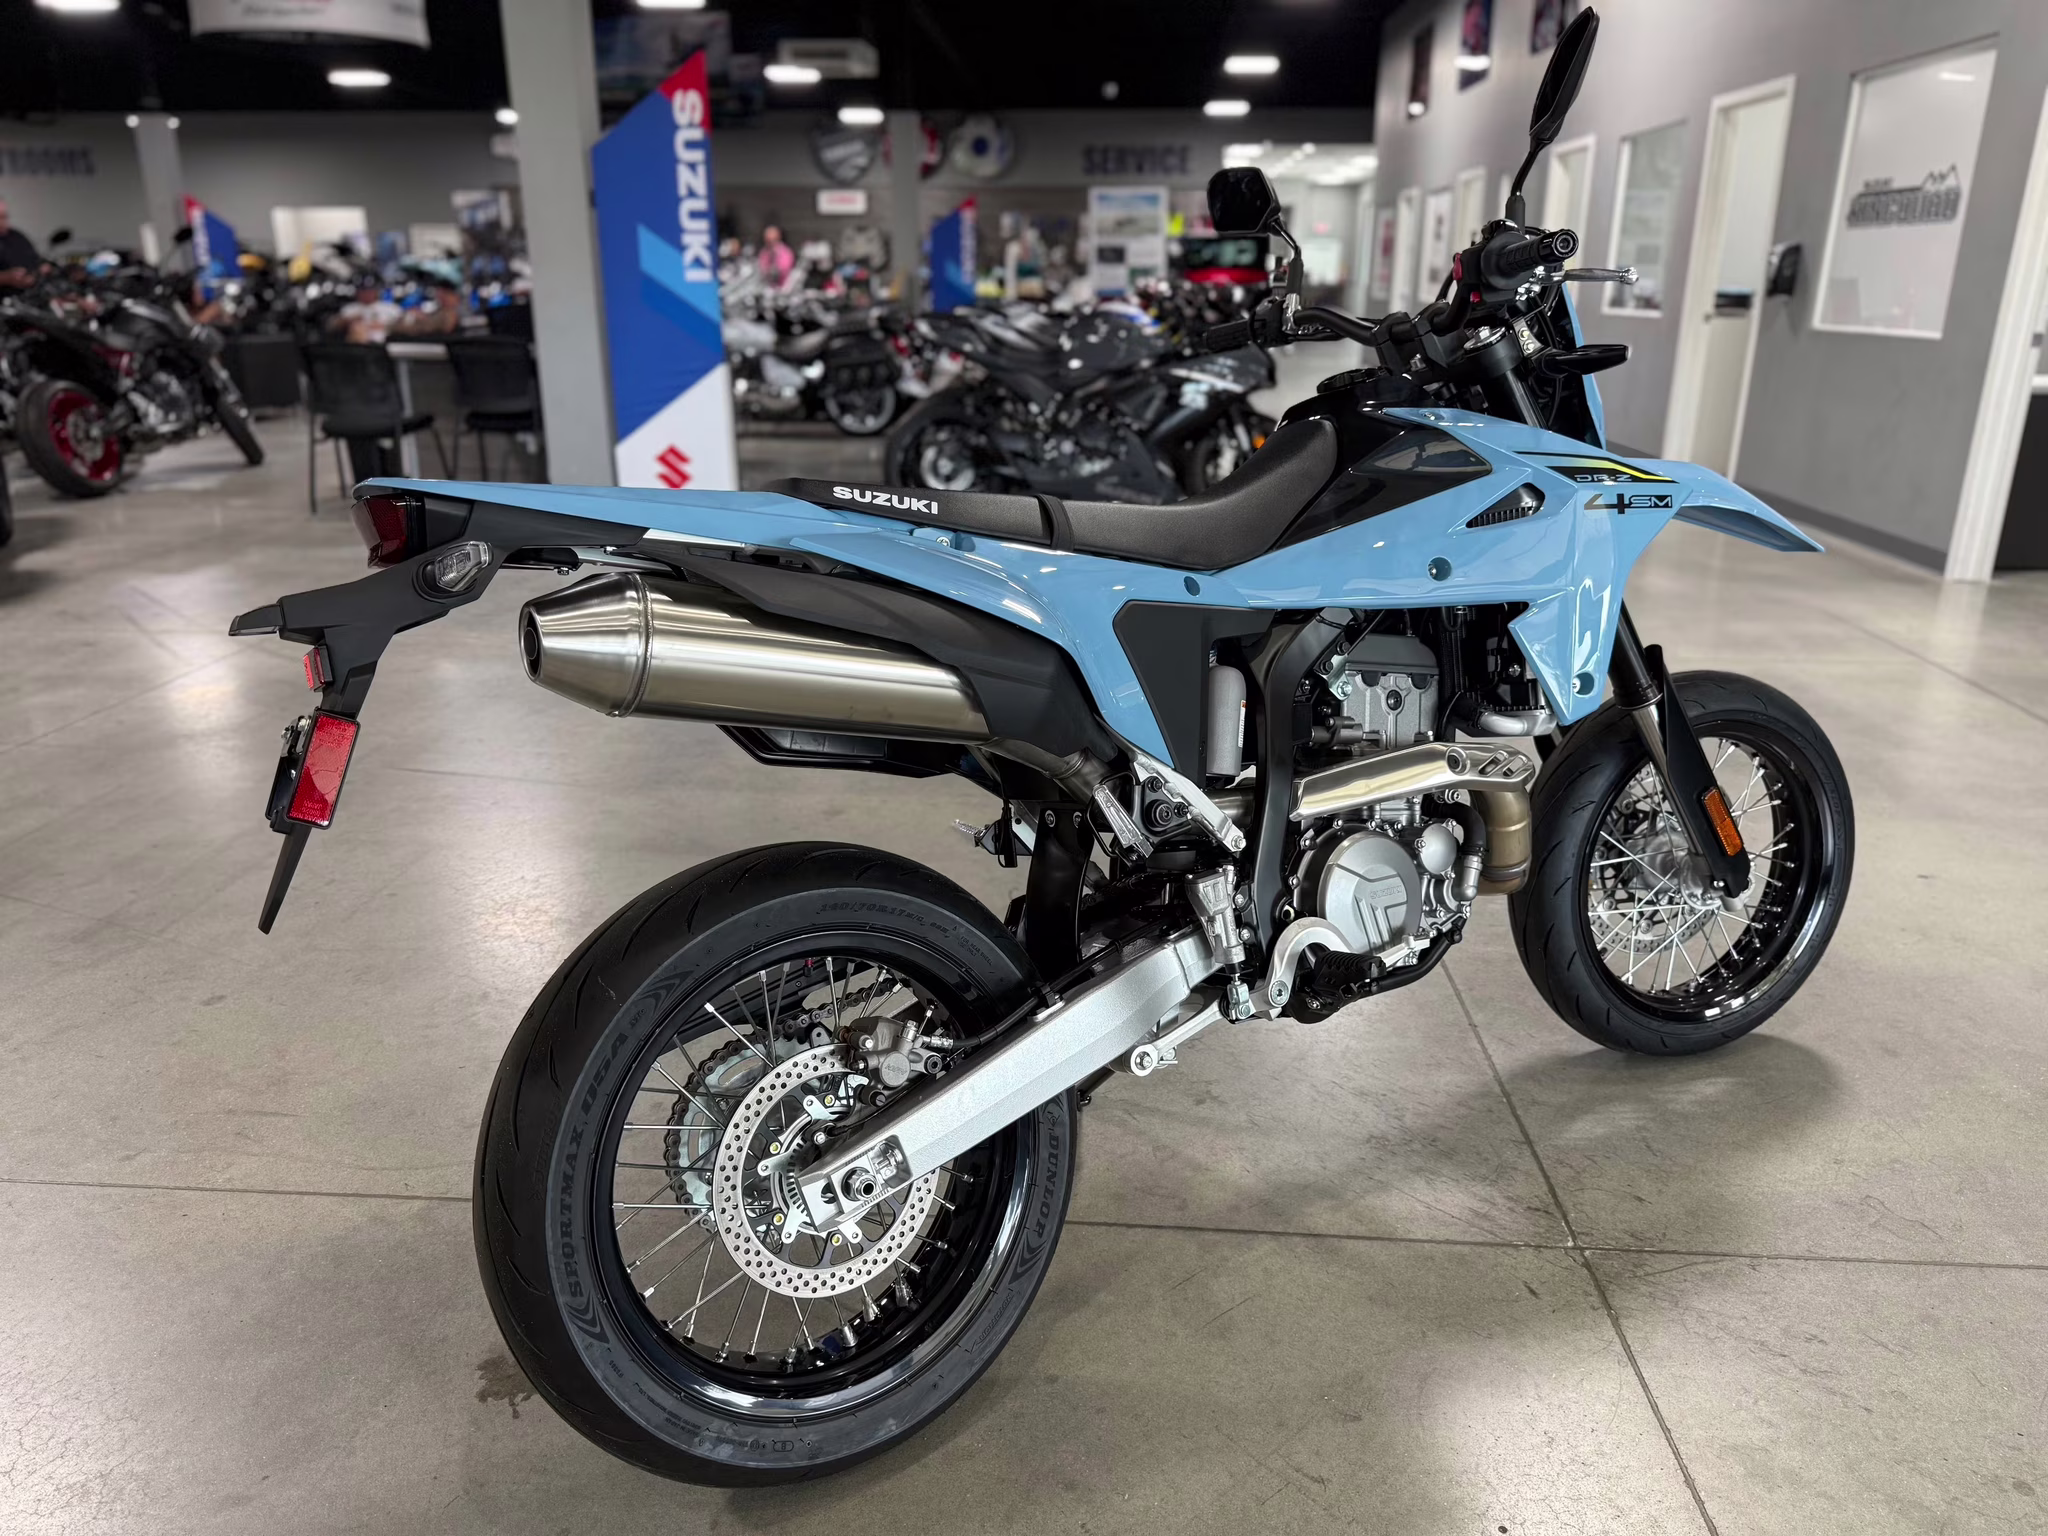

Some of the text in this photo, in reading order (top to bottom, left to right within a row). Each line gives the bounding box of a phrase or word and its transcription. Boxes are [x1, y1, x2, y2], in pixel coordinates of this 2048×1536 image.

[1083, 145, 1190, 177] SERVICE
[672, 87, 714, 283] SUZUKI
[1574, 474, 1632, 482] DR-Z
[832, 486, 939, 515] SUZUKI
[1584, 493, 1673, 515] 4SM
[1369, 885, 1403, 900] SUZUKI
[1034, 1135, 1060, 1239] DUNLOP
[560, 1125, 586, 1298] SPORTMAX
